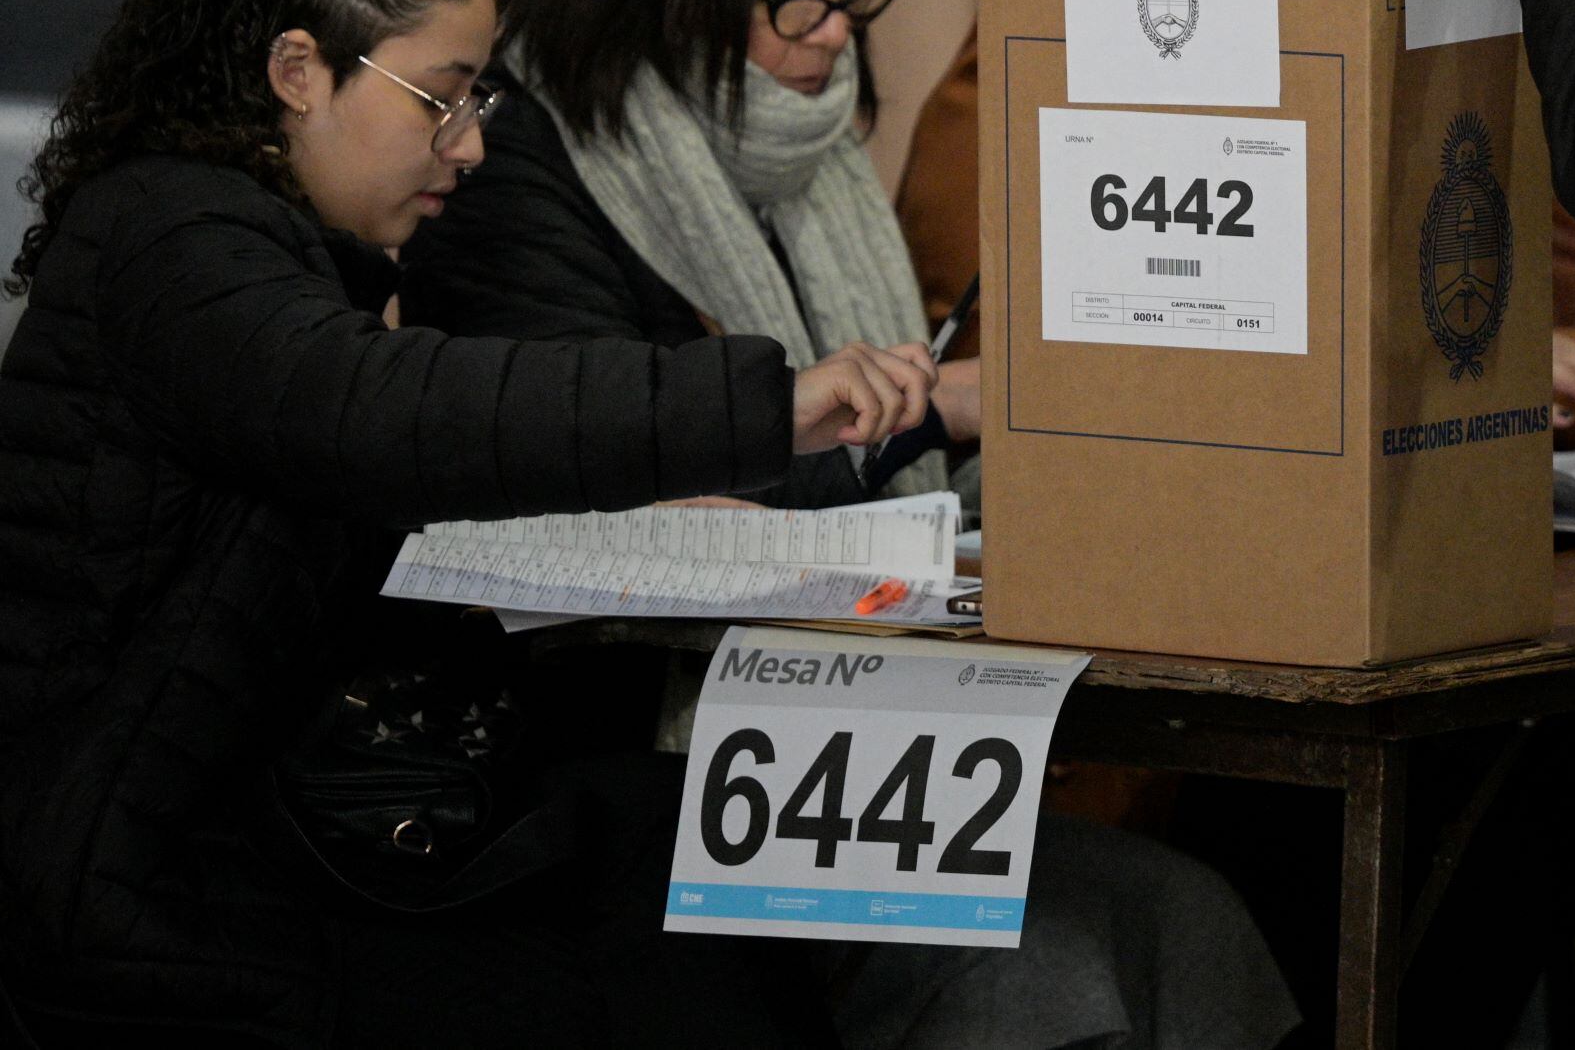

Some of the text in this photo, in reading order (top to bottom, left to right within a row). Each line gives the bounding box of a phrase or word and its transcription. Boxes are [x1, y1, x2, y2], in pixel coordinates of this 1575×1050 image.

[1065, 135, 1084, 143] URNA
[1090, 173, 1255, 238] 6442
[1085, 296, 1226, 311] DISTRITO CAPITAL FEDERAL
[1133, 312, 1163, 322] 00014
[1236, 318, 1260, 328] 0151
[1382, 405, 1549, 456] ELECCIONES ARGENTINAS
[718, 647, 822, 686] Mesa
[700, 727, 1023, 876] 6442
